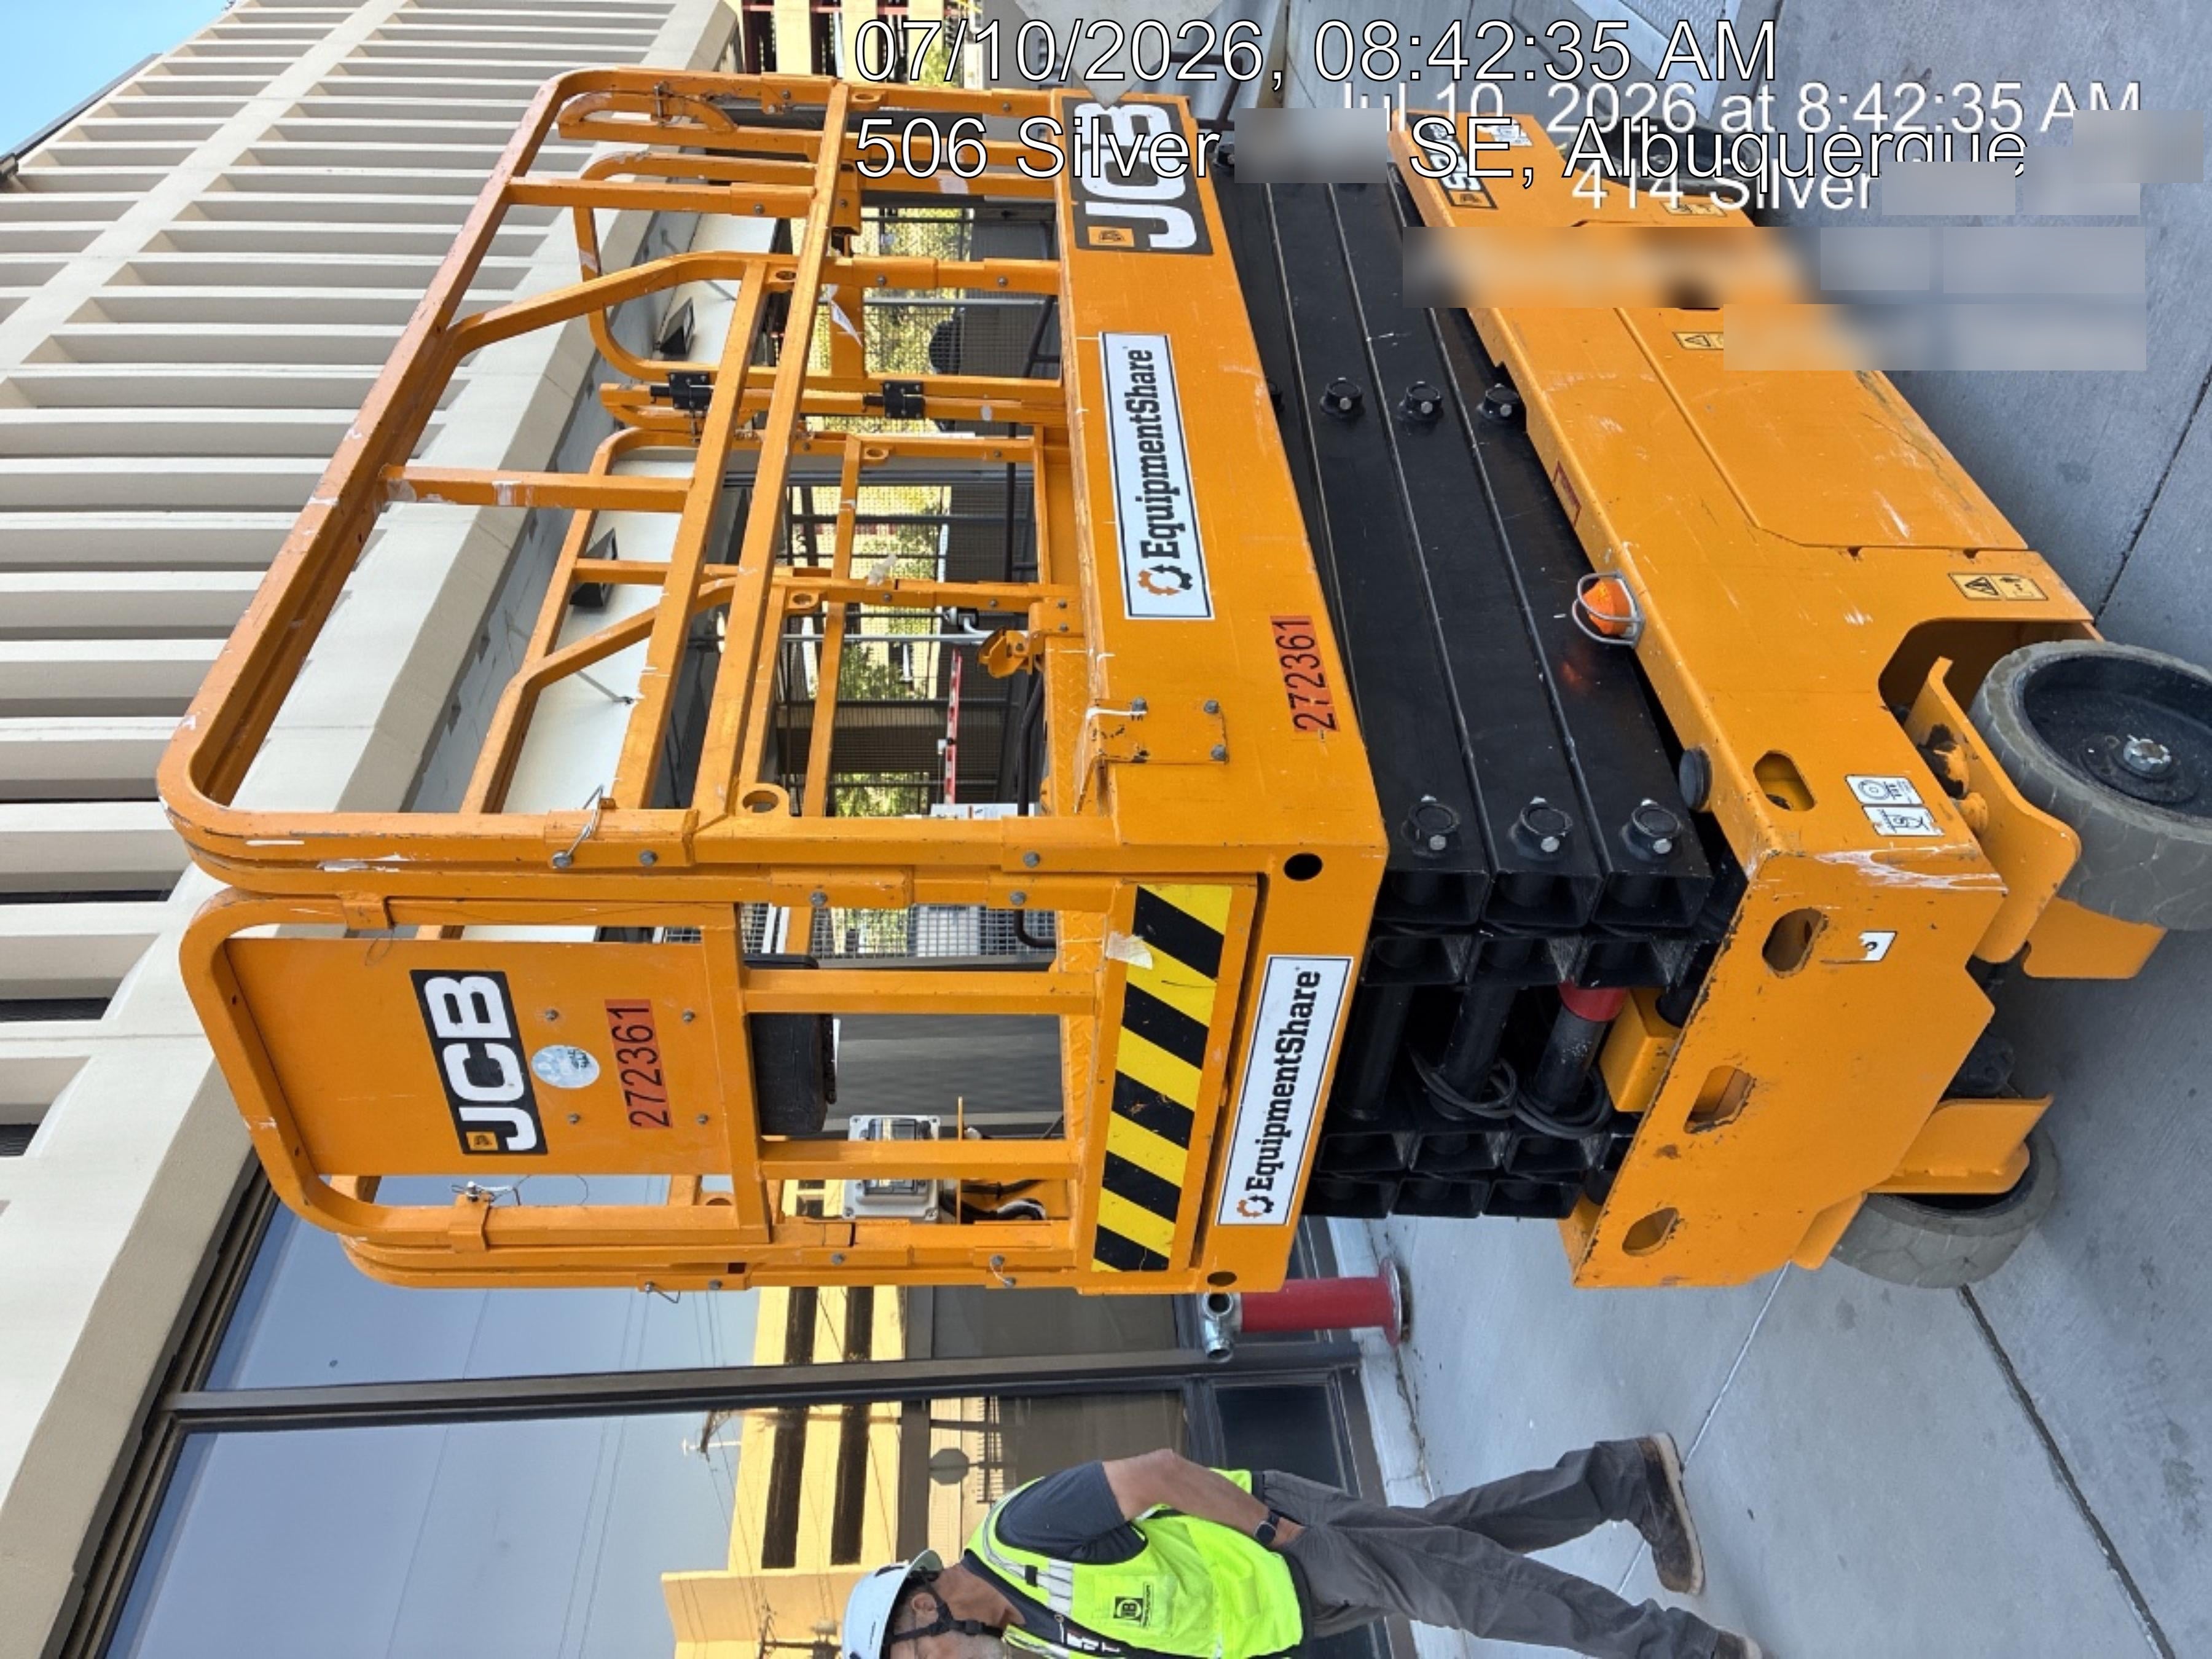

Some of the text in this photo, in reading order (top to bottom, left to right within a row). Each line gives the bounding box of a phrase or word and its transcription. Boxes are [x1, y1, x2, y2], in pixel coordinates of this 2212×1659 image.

[1073, 103, 1198, 249] JCB
[1123, 350, 1185, 559] EquipmentShare
[1271, 618, 1336, 731] 272361
[423, 976, 538, 1151] JCB
[606, 1005, 669, 1127] 272361
[1246, 971, 1321, 1191] EquipmentShare
